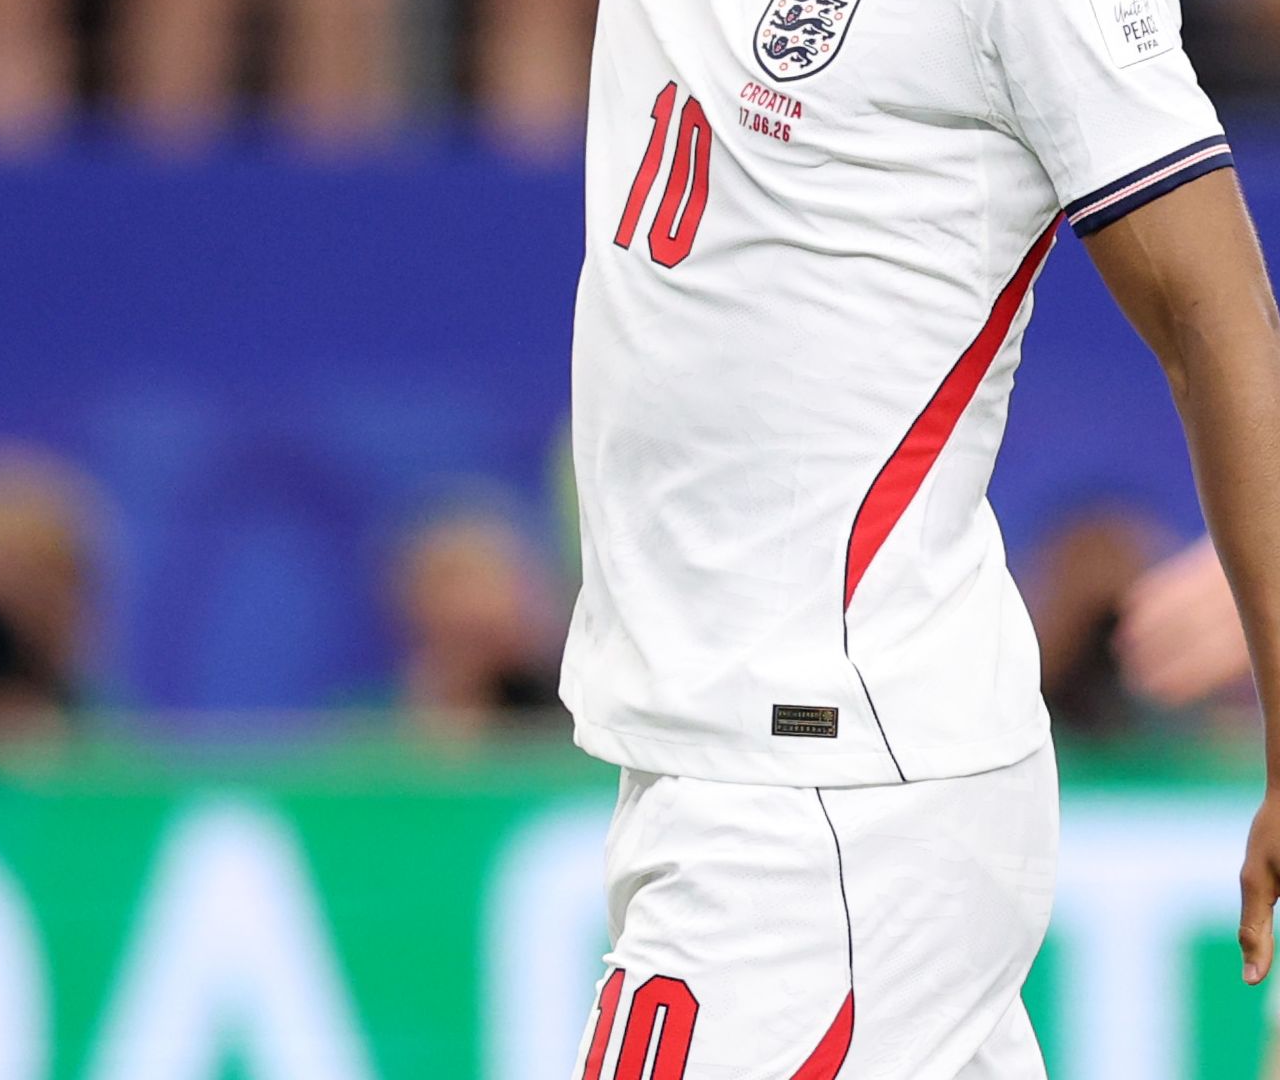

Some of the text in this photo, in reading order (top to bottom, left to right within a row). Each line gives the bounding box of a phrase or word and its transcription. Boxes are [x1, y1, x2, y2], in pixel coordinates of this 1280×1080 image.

[1122, 14, 1159, 43] PEAC
[740, 81, 802, 119] CROATIA
[738, 107, 791, 143] 17.06.26
[613, 80, 712, 269] 10
[582, 968, 700, 1080] 10
